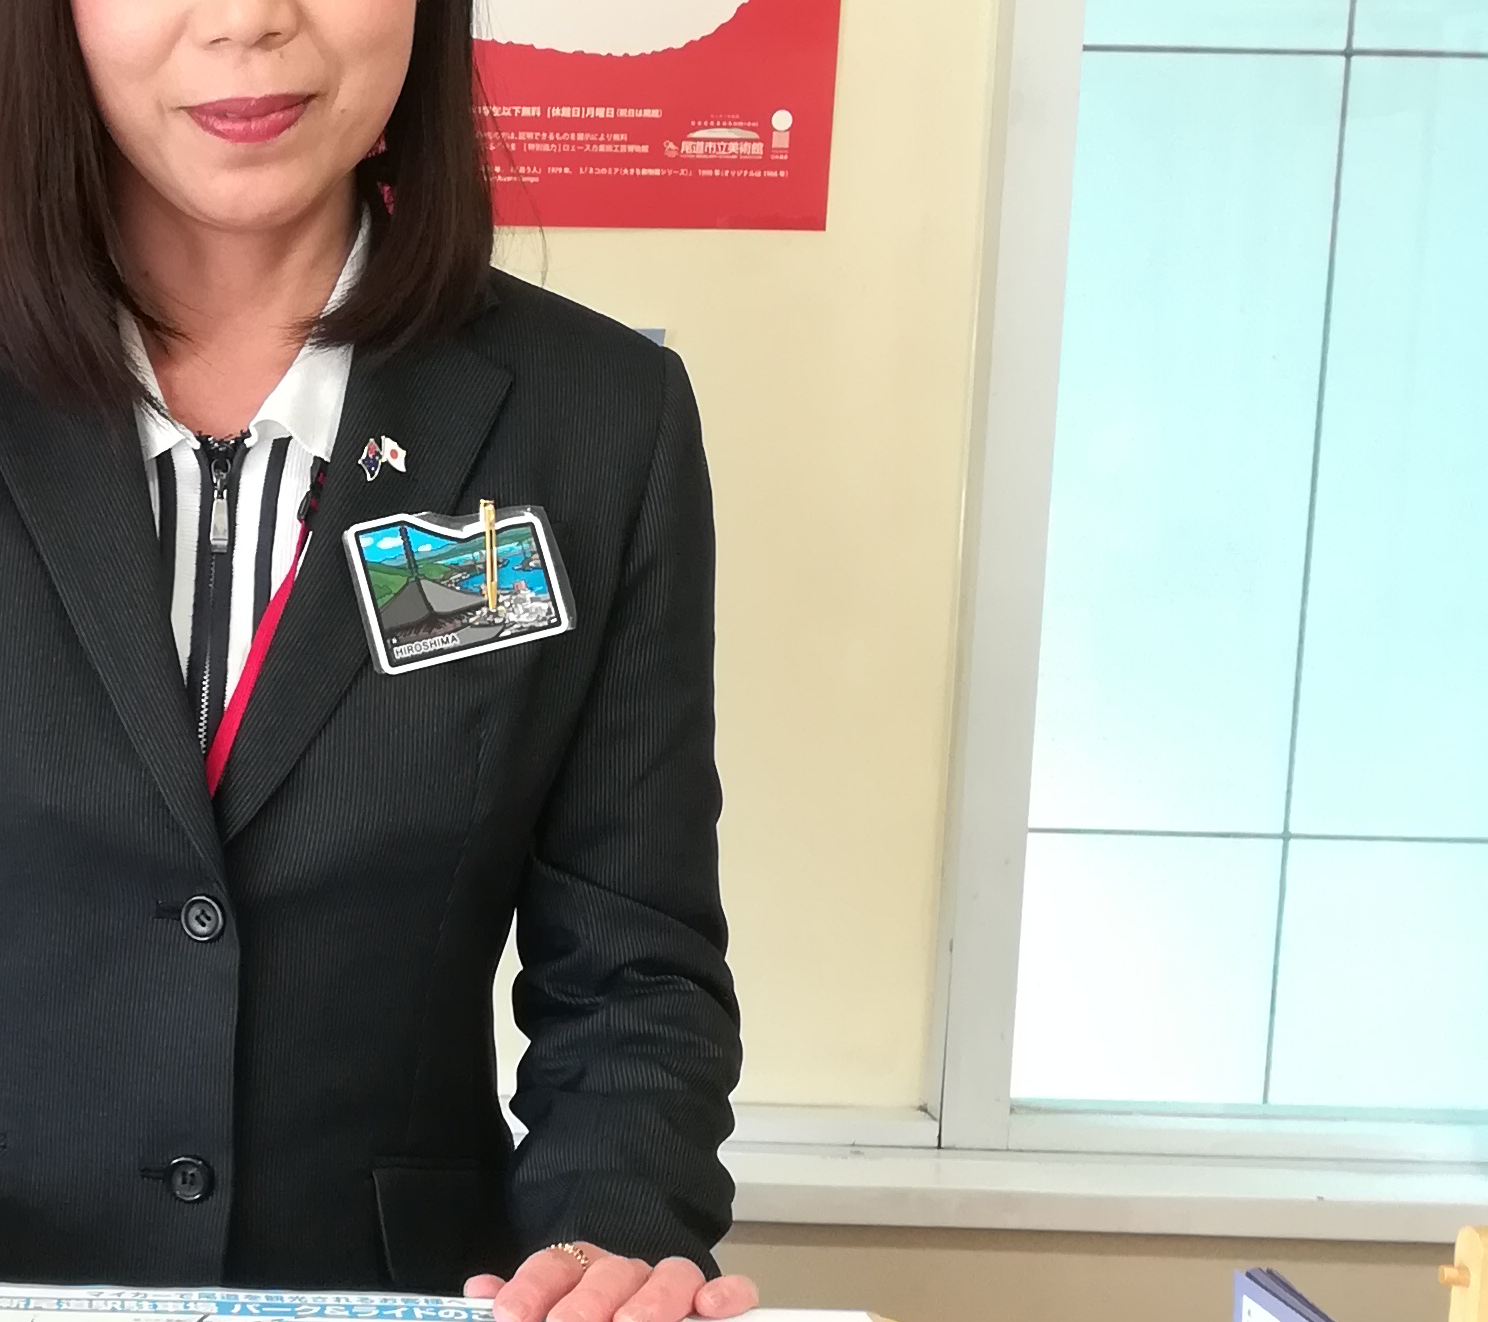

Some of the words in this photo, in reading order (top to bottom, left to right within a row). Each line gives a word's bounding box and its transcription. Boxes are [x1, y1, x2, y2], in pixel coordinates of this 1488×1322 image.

[680, 140, 764, 155] 尾道市立美術館
[394, 634, 460, 659] HIROSHIMA
